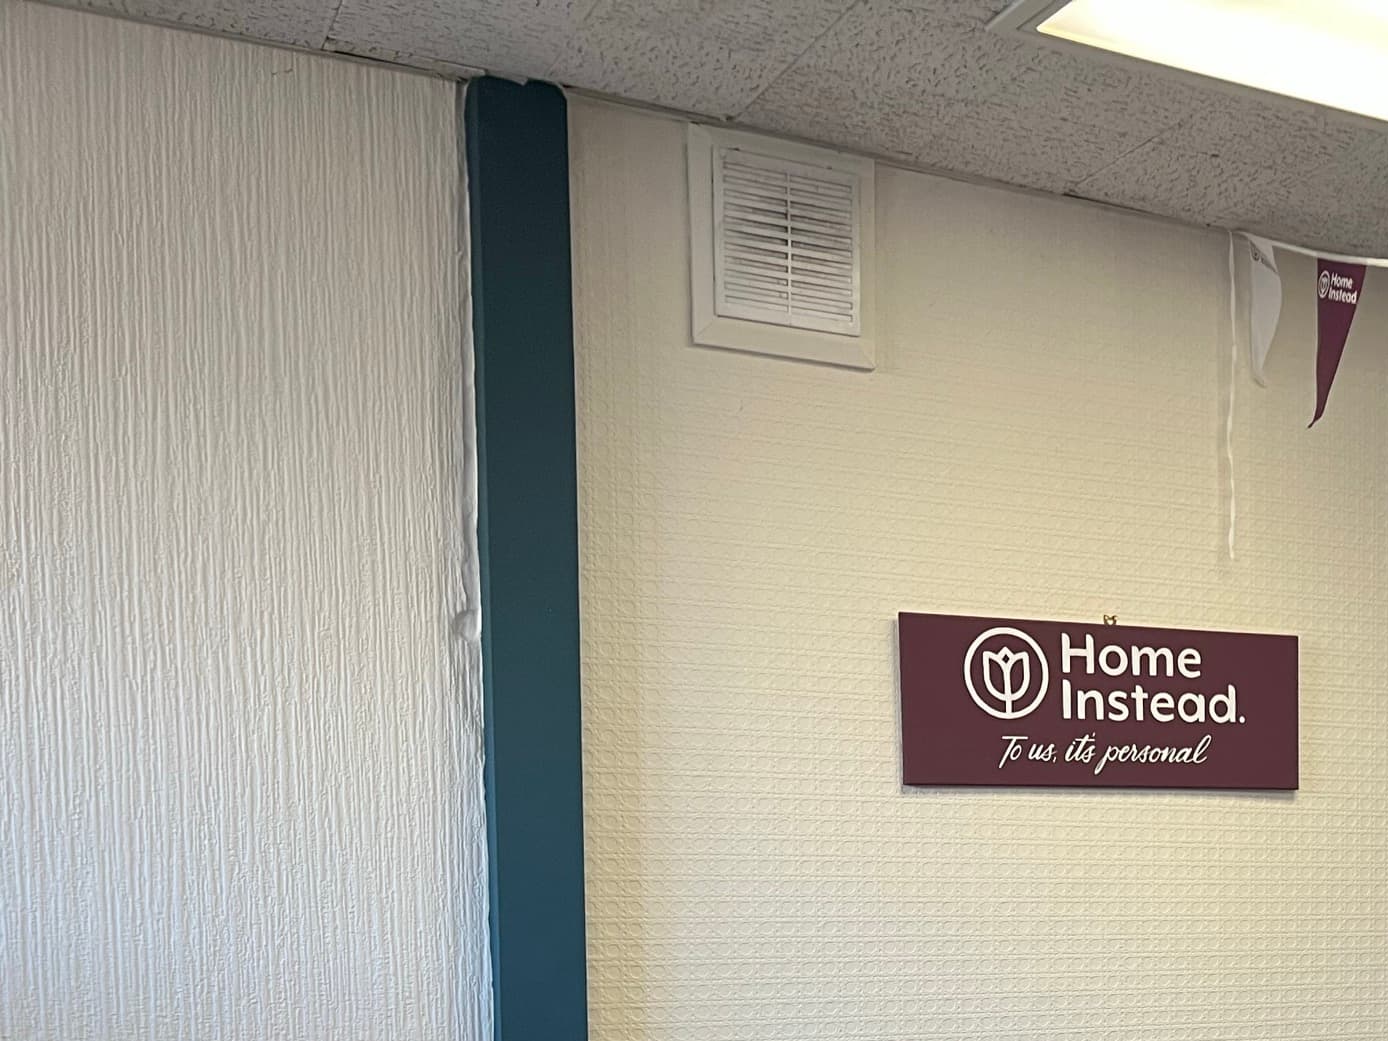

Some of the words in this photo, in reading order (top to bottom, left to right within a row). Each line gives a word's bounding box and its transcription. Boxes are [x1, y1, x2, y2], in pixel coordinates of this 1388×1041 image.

[1328, 287, 1358, 305] Instead
[1330, 272, 1353, 290] Home
[1061, 632, 1202, 678] Home
[1061, 678, 1246, 725] Instead.
[998, 734, 1028, 770] To
[1094, 734, 1213, 776] personal
